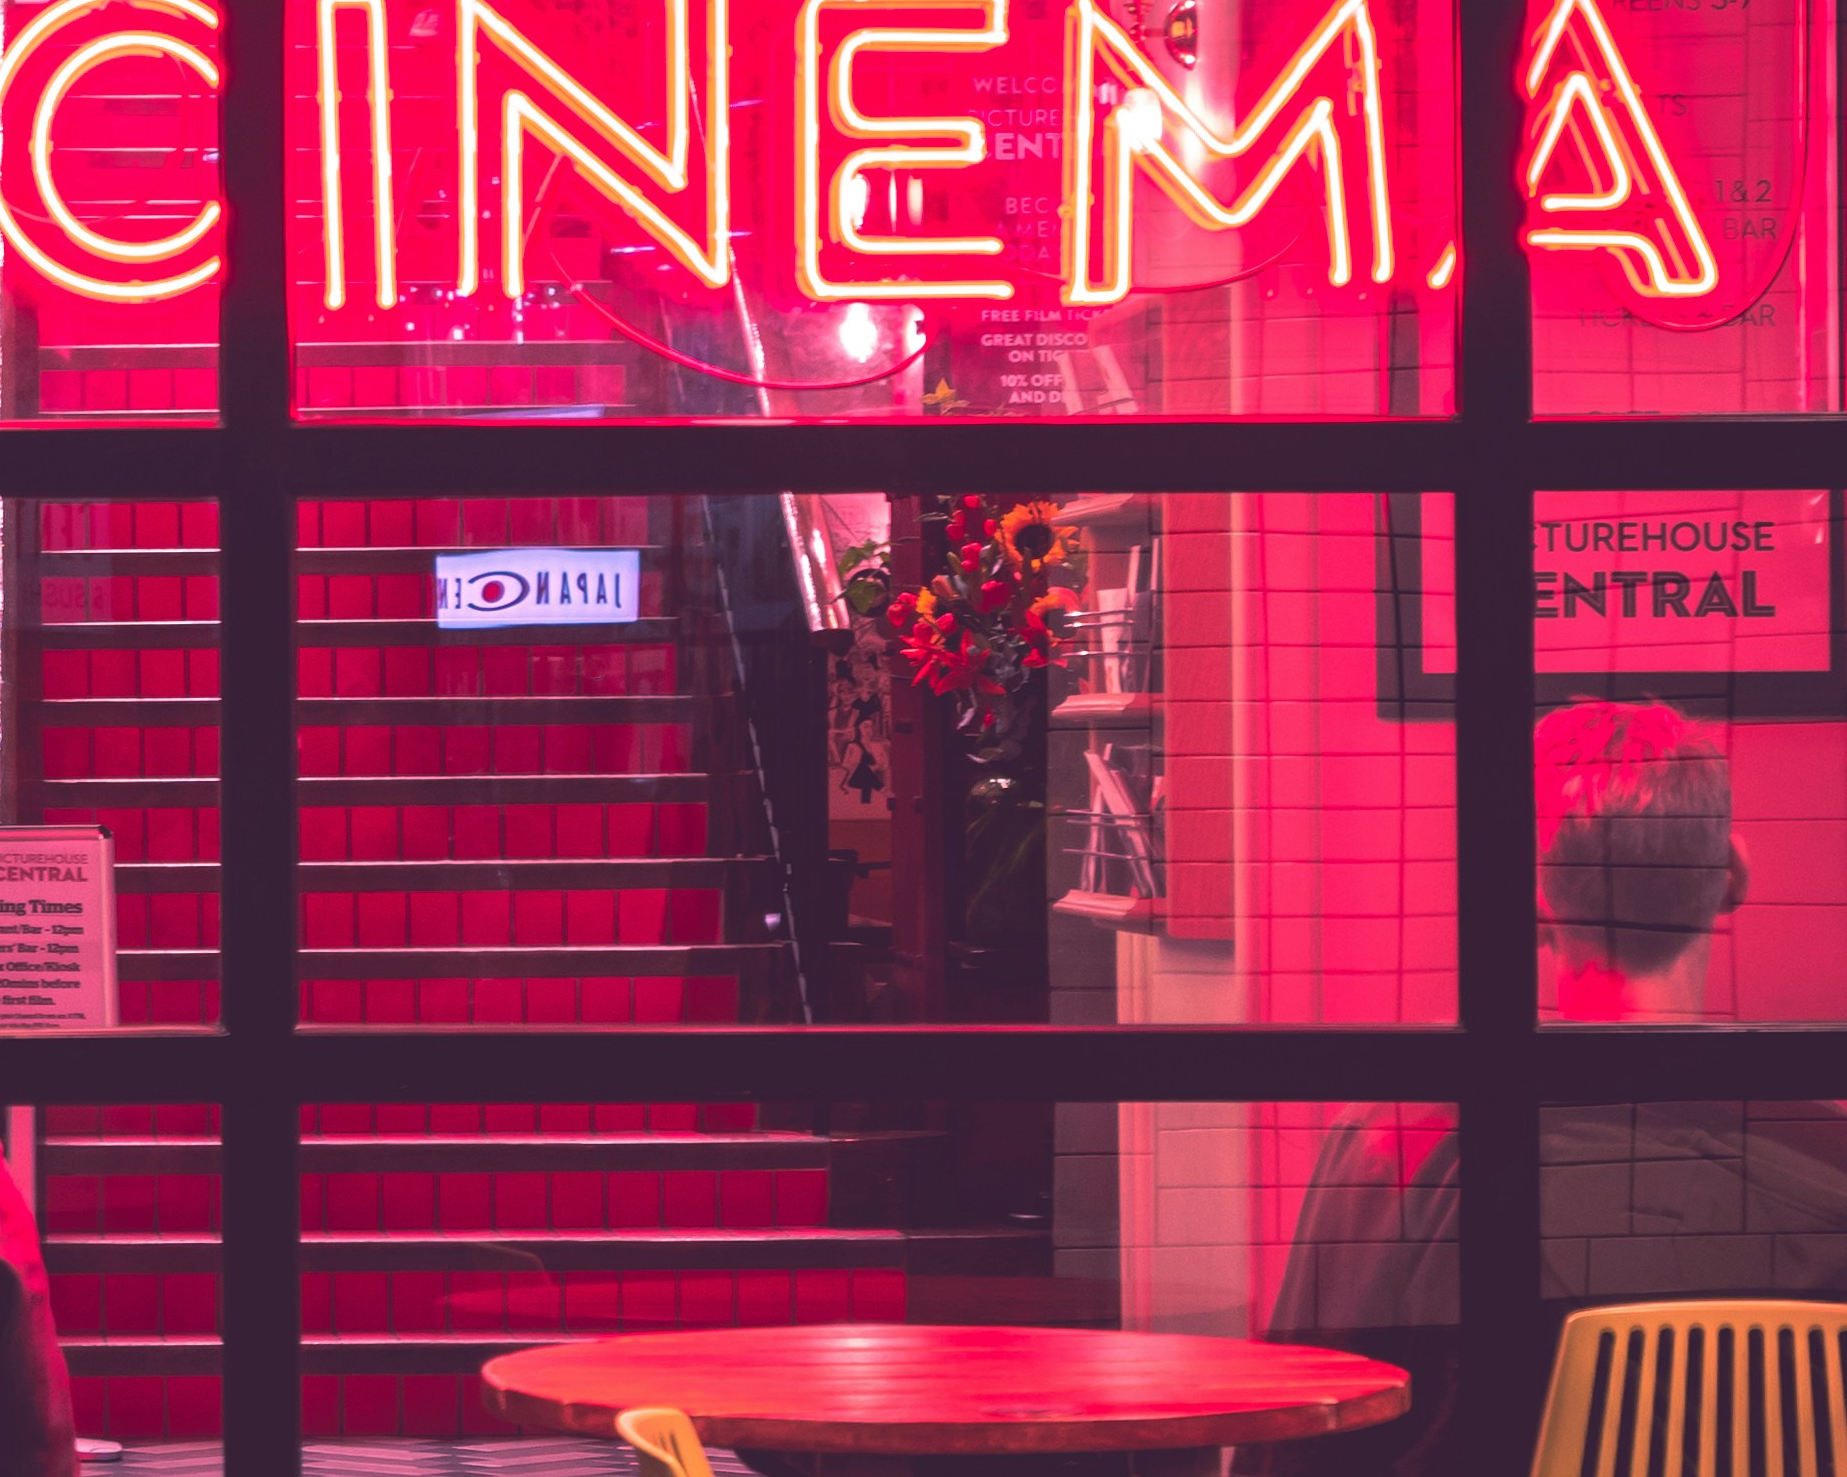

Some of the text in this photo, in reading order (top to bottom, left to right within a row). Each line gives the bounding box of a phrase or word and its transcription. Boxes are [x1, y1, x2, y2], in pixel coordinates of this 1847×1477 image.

[973, 76, 1057, 94] WELCO
[980, 309, 1021, 323] FREE
[1024, 309, 1062, 323] FILM
[980, 333, 1088, 347] GREAT DISCO
[1008, 350, 1034, 363] ON
[1000, 373, 1064, 388] 10% OFF
[1008, 390, 1047, 404] AND
[1530, 521, 1776, 553] TUREHOUSE
[1533, 569, 1776, 619] ENTRAL
[27, 898, 83, 914] Times
[17, 943, 38, 953] Bar
[41, 978, 81, 989] before
[2, 995, 27, 1005] first
